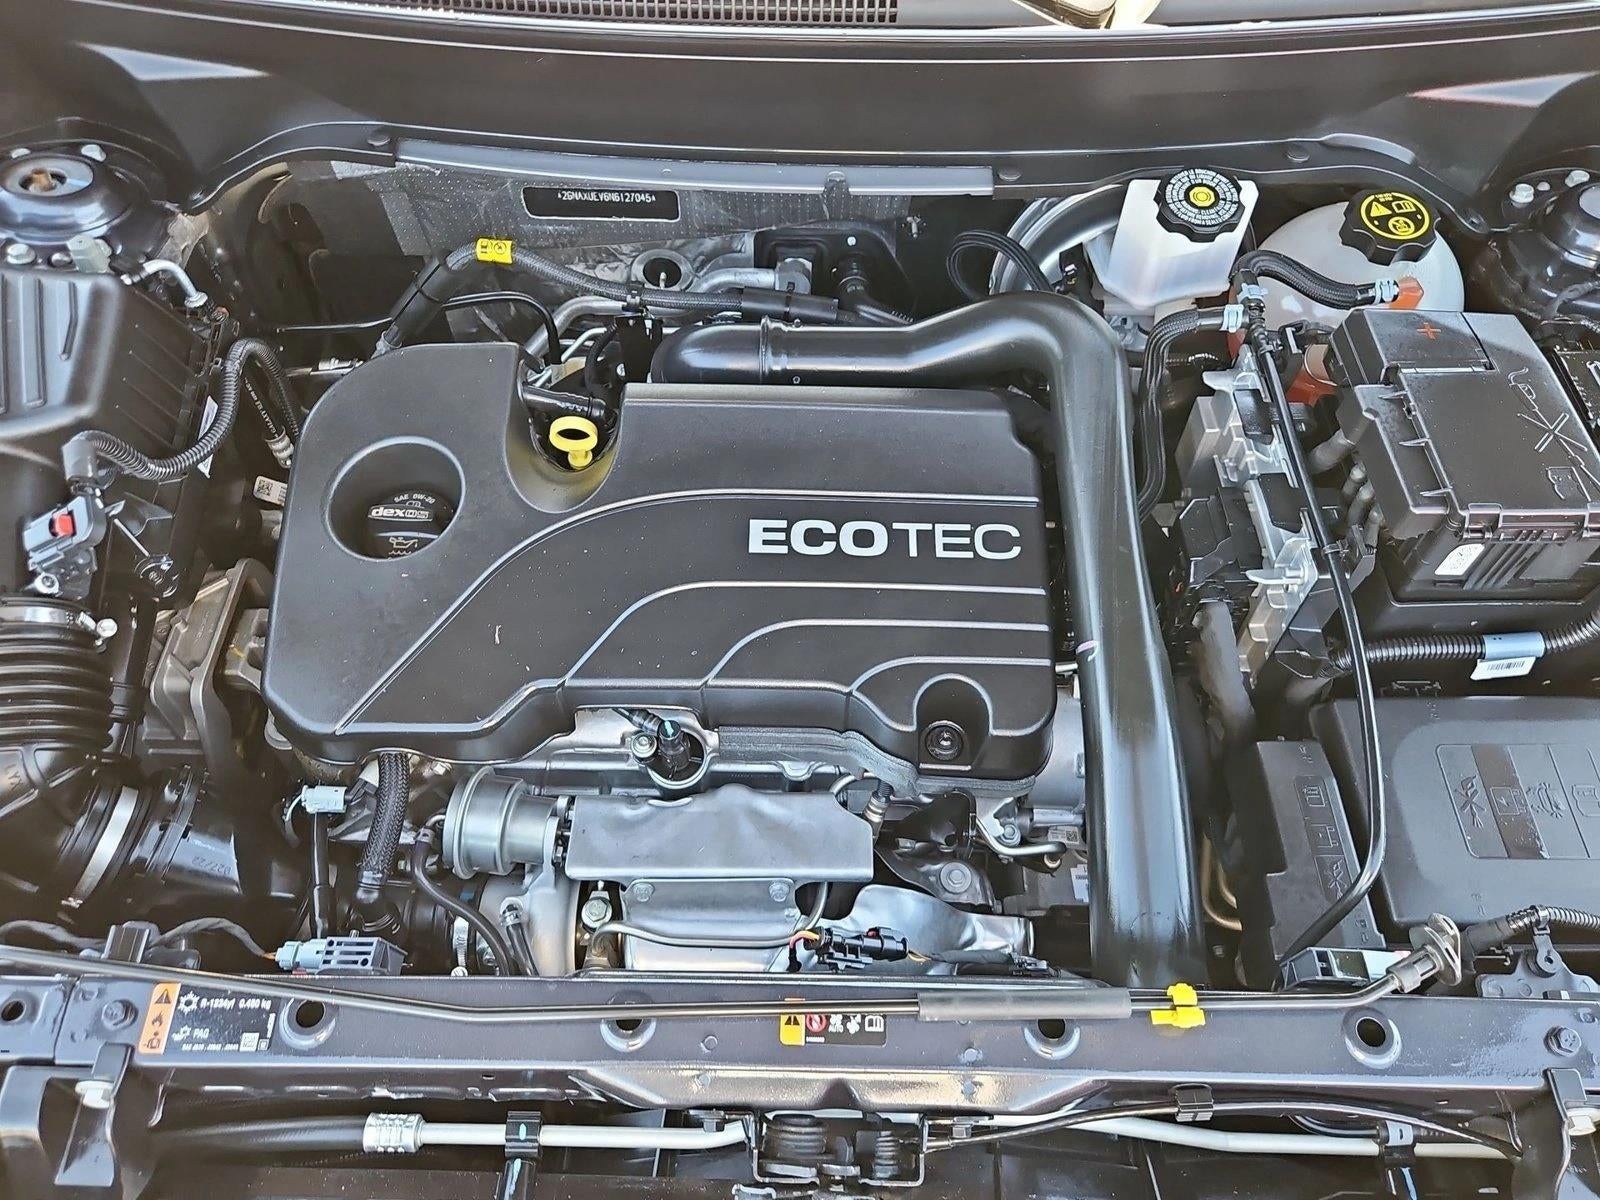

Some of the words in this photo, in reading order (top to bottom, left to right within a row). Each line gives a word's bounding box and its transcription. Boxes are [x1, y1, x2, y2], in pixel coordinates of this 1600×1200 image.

[393, 494, 409, 503] SAE
[412, 493, 436, 504] 0W-20
[371, 506, 430, 519] dexos
[748, 518, 1022, 560] ECOTEC
